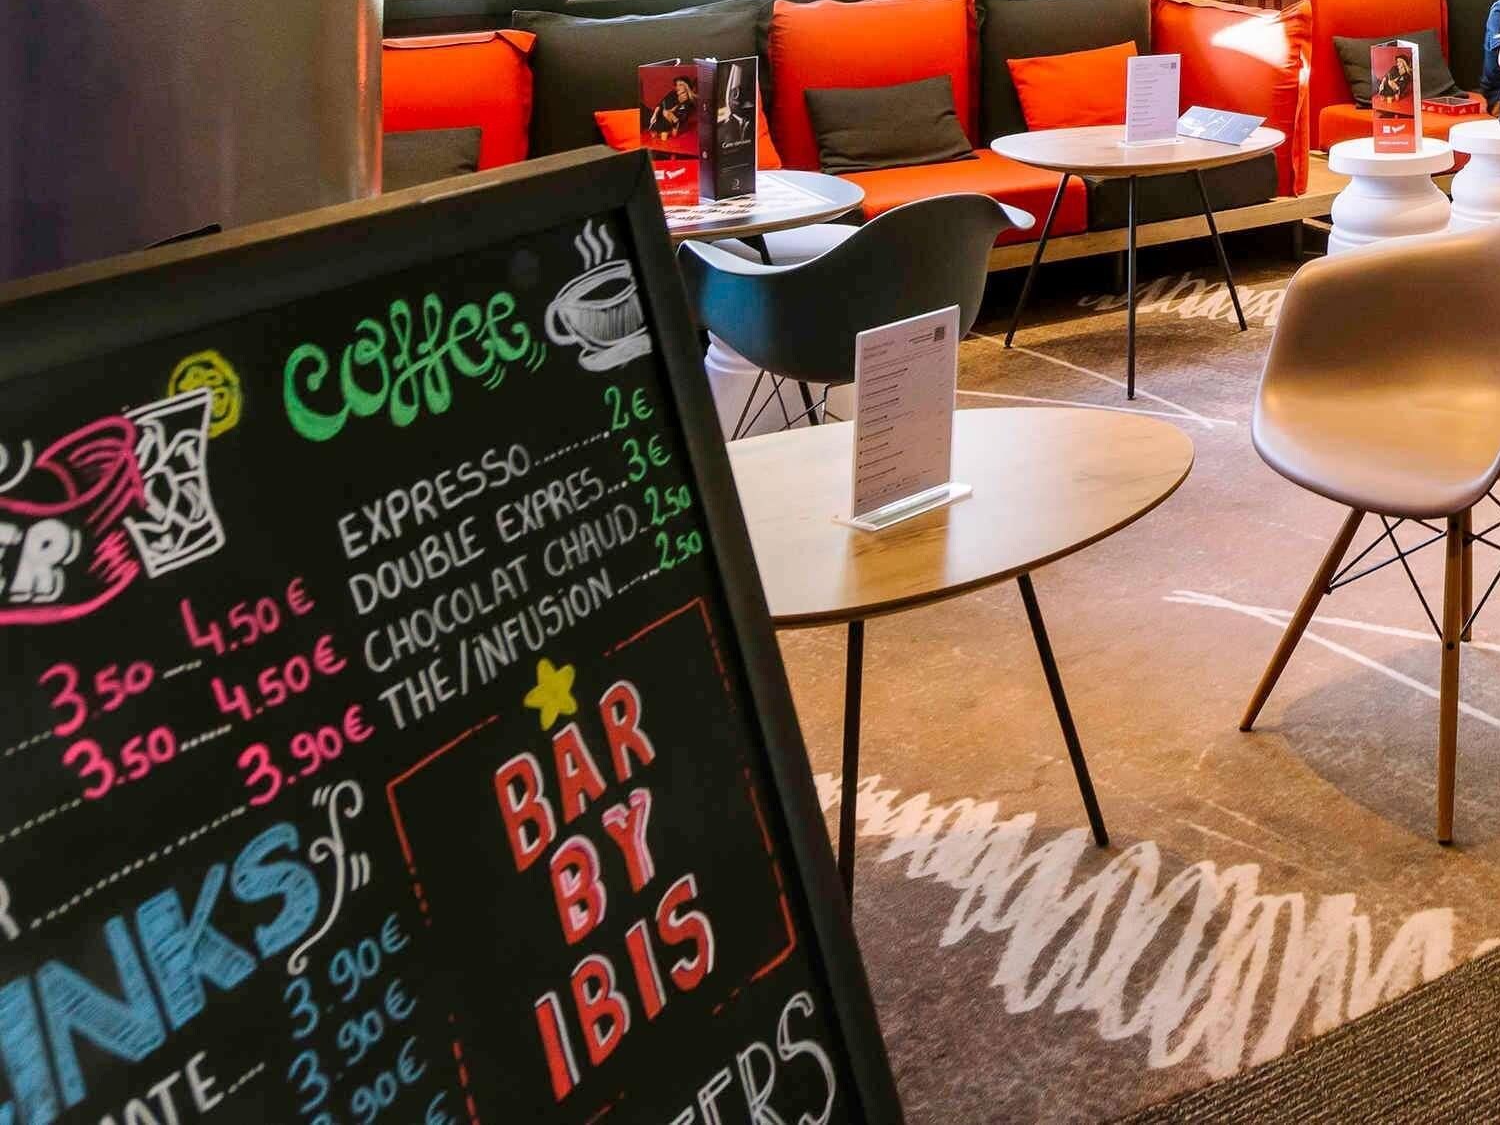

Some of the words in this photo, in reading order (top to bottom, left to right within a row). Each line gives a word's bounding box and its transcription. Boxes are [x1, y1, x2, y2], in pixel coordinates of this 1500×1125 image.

[337, 443, 530, 560] EXPRESSO
[604, 385, 653, 431] 2€
[349, 515, 486, 615] DOUBLE
[495, 466, 605, 544] EXPRES
[622, 434, 672, 482] 3€
[363, 554, 529, 673] CHOCOLAT
[543, 503, 638, 577] CHAUD
[62, 725, 177, 800] 3.50
[211, 634, 348, 721] 4.50€
[236, 704, 376, 806] 3.90€
[494, 679, 656, 873] BAR
[549, 787, 654, 946] BY
[0, 823, 320, 1125] INKS
[534, 873, 715, 1103] IBIS
